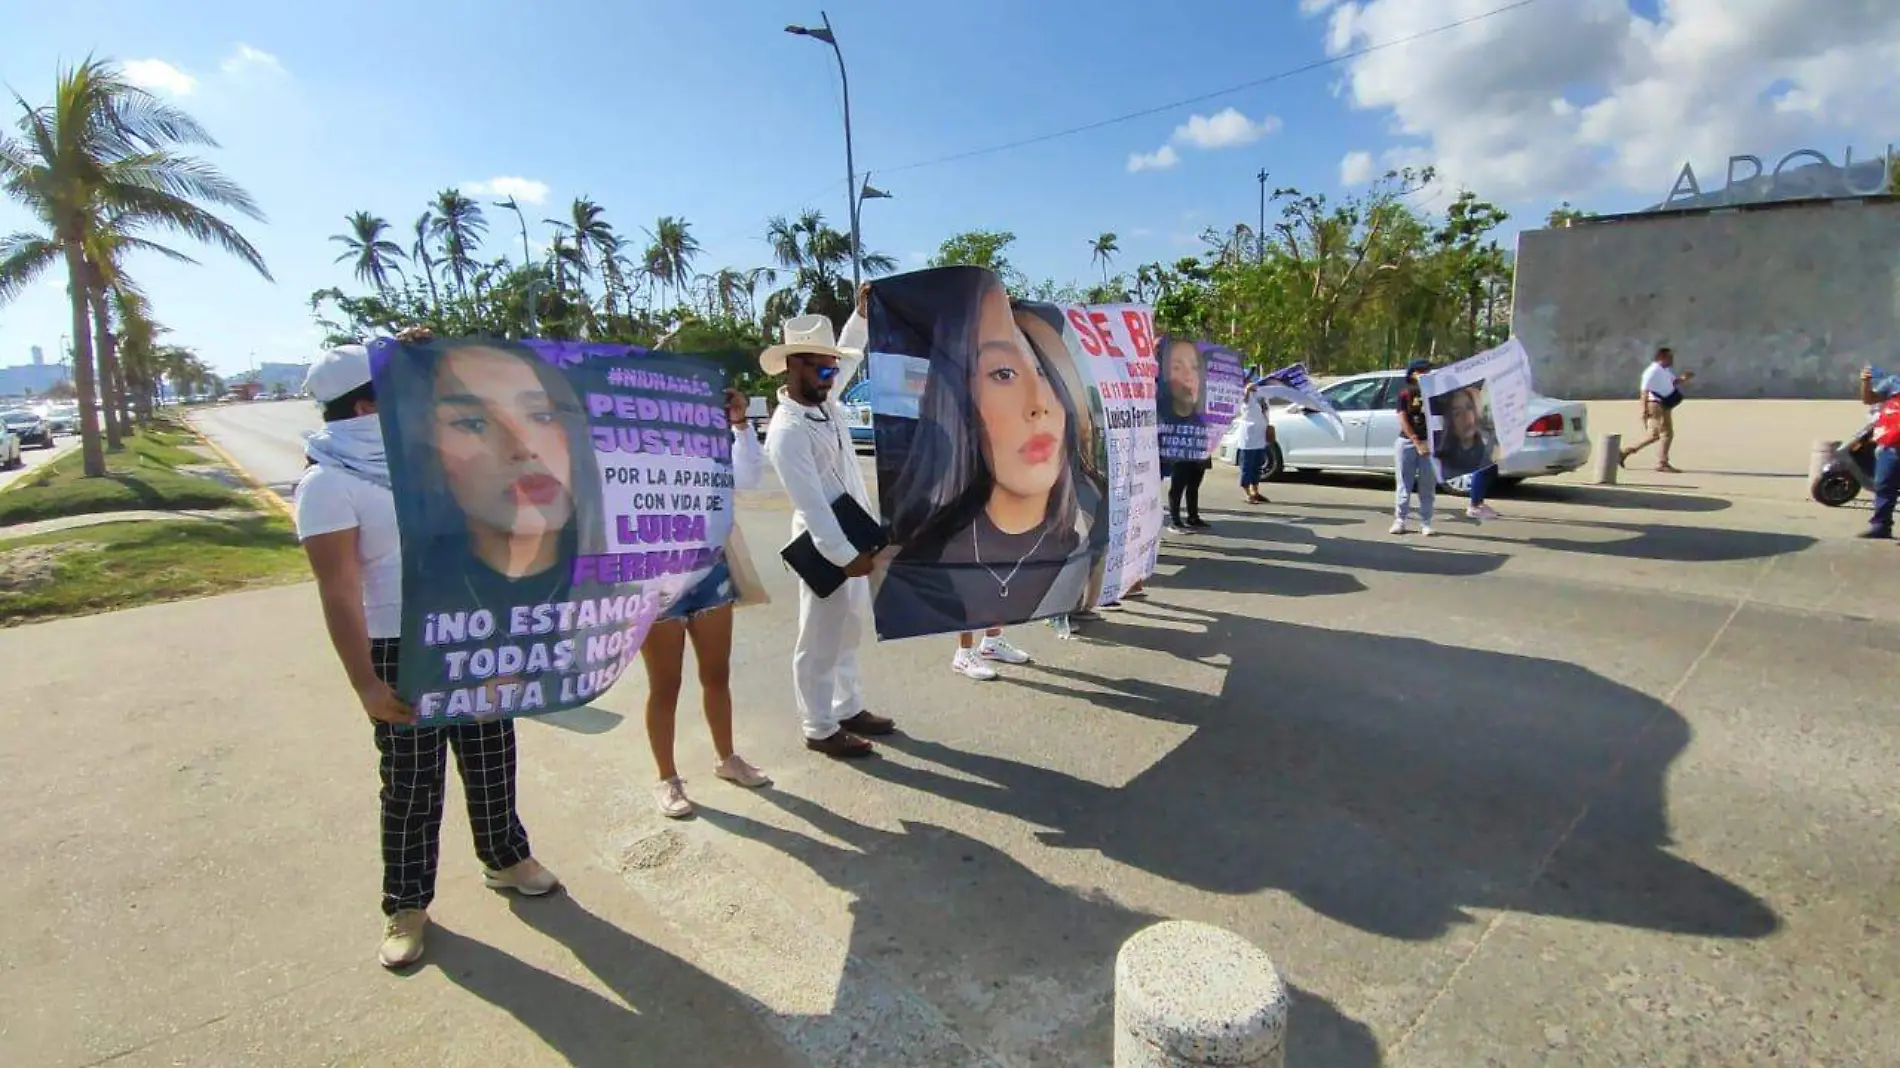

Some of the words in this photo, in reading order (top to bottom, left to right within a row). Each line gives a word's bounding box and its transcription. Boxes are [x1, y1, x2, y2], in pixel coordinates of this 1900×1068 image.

[1067, 309, 1125, 357] SE
[1122, 311, 1154, 357] B
[587, 392, 728, 430] PEDIMOS
[605, 467, 640, 484] POR
[647, 468, 667, 486] LA
[633, 493, 666, 510] CON
[671, 494, 701, 511] VIDA
[616, 514, 706, 545] LUISA
[509, 590, 659, 637] ESTAMOS
[446, 637, 576, 682] TODAS
[586, 626, 637, 664] NOS
[420, 679, 547, 720] FALTA
